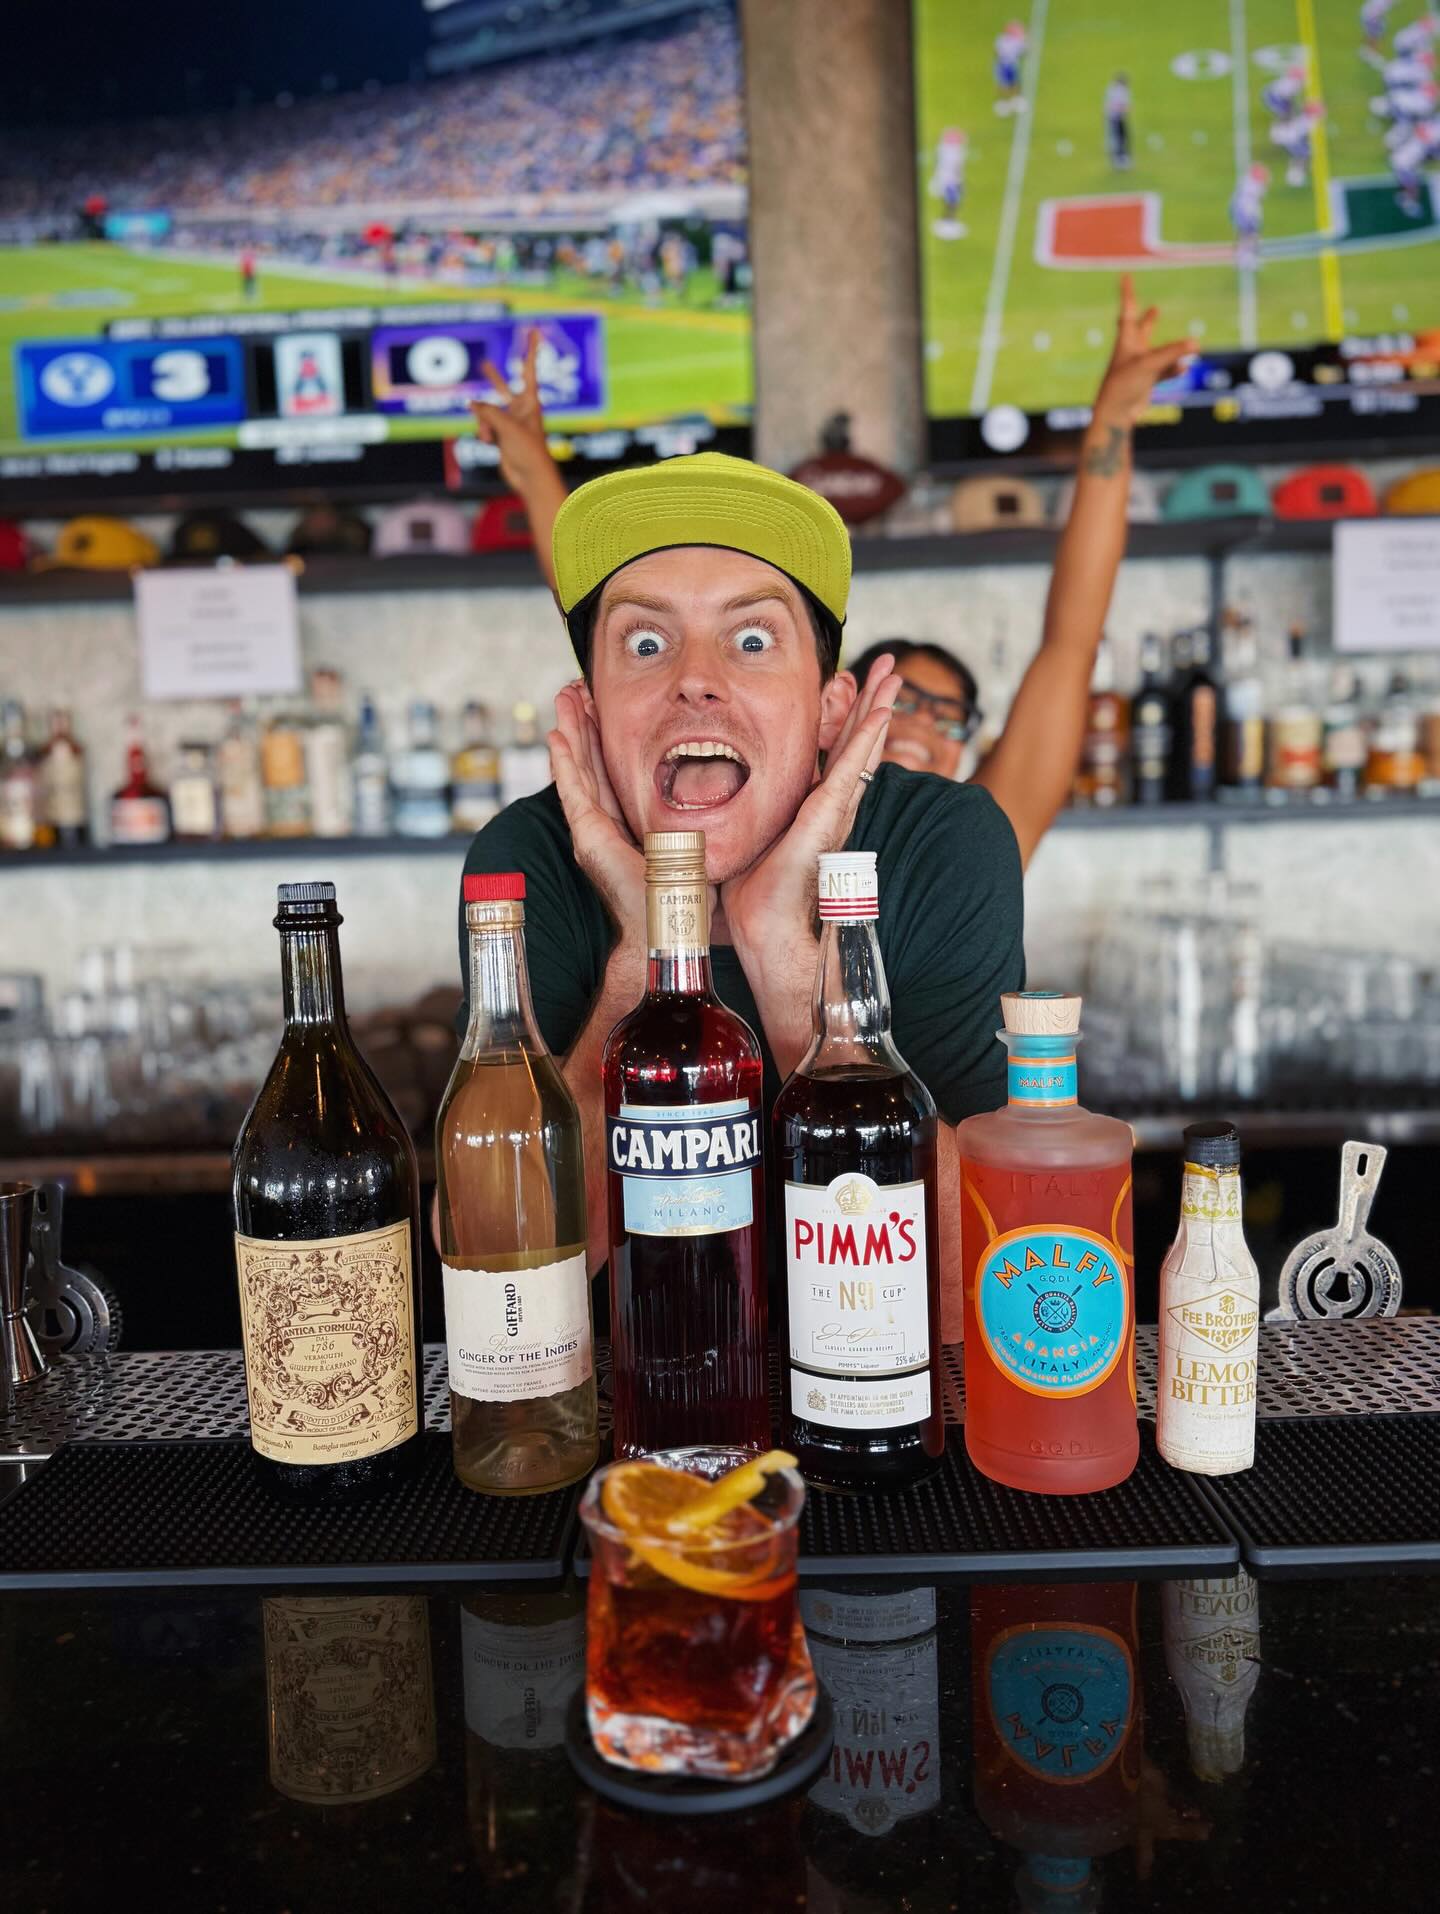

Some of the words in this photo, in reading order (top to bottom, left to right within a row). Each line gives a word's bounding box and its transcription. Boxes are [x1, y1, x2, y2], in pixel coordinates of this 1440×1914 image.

[407, 337, 470, 388] 0
[151, 350, 210, 401] 3
[660, 894, 702, 905] CAMPARI
[1019, 1076, 1064, 1088] MALFY
[612, 1119, 759, 1170] CAMPARI
[654, 1204, 725, 1217] MILANO
[795, 1211, 917, 1266] PIMM'S
[992, 1243, 1114, 1290] MALFY
[812, 1287, 831, 1298] THE
[504, 1283, 518, 1337] GIFFARD
[1182, 1307, 1202, 1325] FEE
[1205, 1309, 1258, 1327] BROTHER
[283, 1326, 315, 1338] ANTICA
[318, 1322, 364, 1333] FORMULA
[311, 1340, 335, 1353] 1786
[459, 1348, 496, 1363] GINGER
[499, 1354, 515, 1363] OF
[519, 1351, 541, 1362] THE
[545, 1340, 578, 1357] INDIES
[304, 1352, 343, 1361] VERMOUTH
[895, 1356, 908, 1366] 25%
[289, 1364, 319, 1372] GIUSEPPE
[1176, 1357, 1258, 1384] LEMON
[295, 1412, 330, 1425] PRODOTTO
